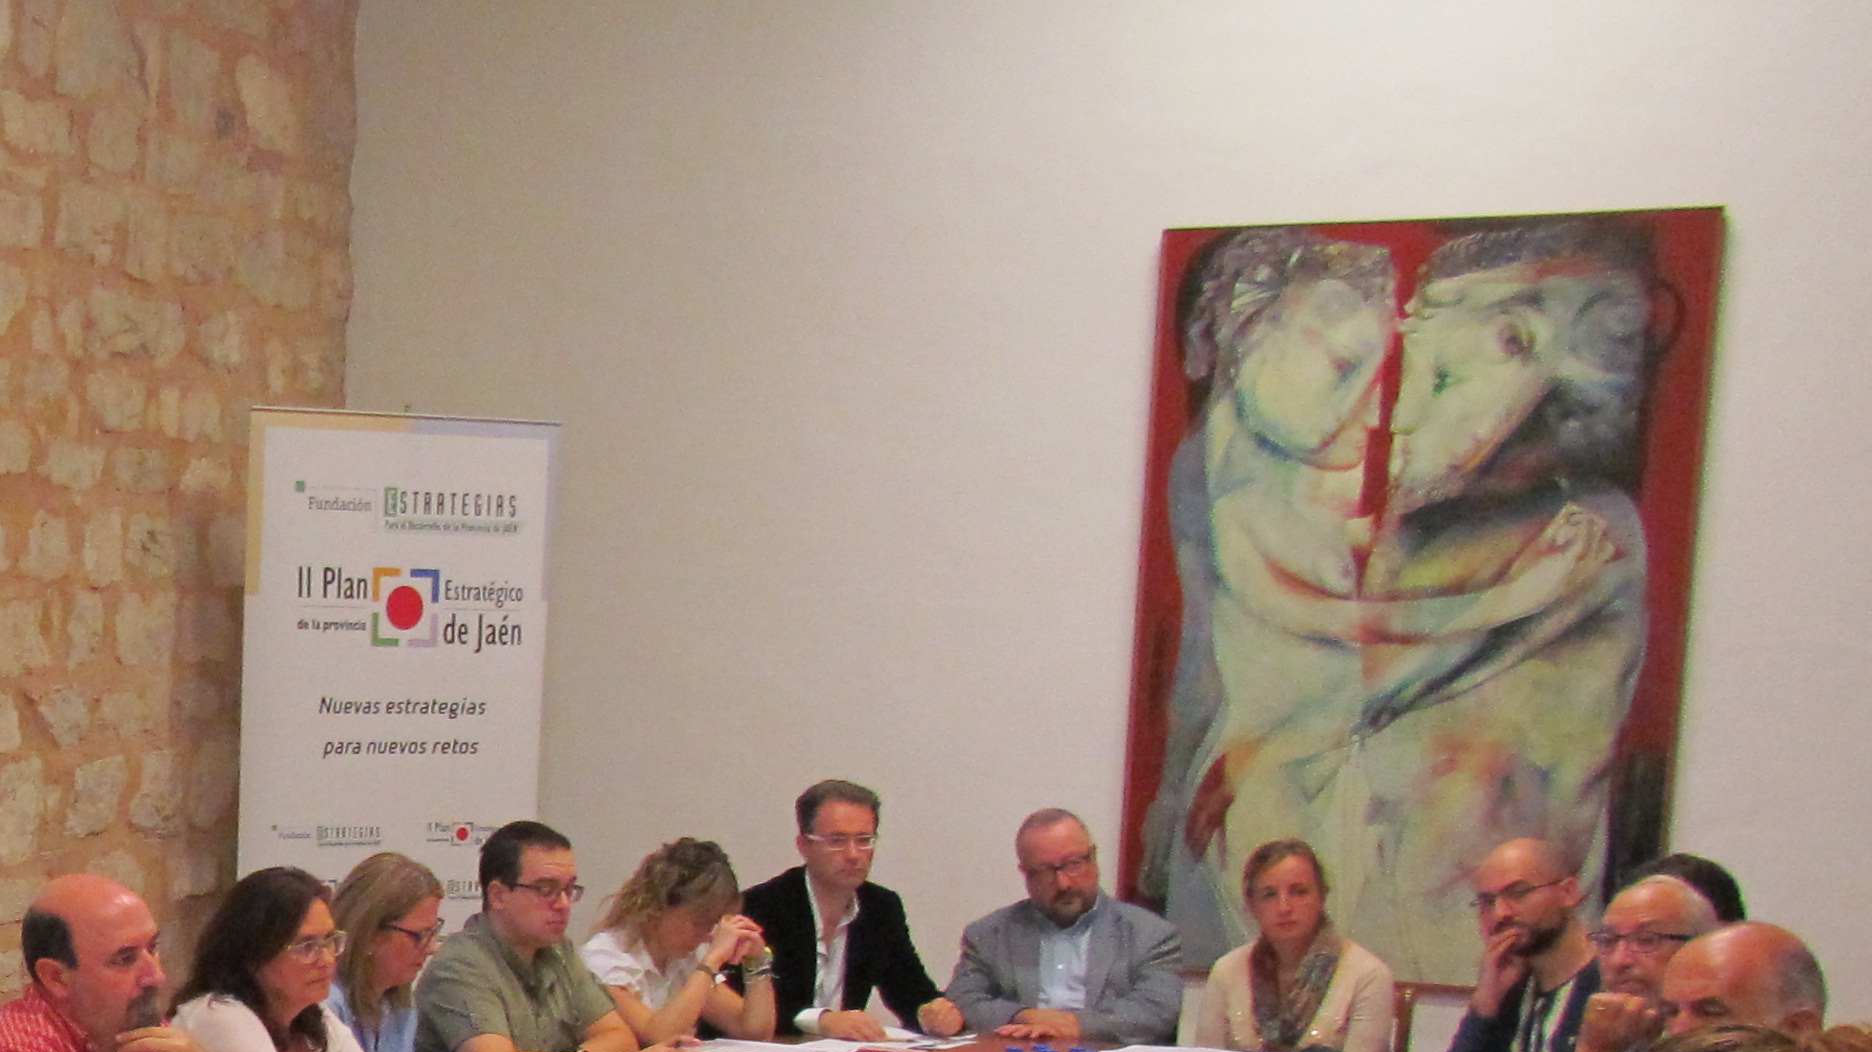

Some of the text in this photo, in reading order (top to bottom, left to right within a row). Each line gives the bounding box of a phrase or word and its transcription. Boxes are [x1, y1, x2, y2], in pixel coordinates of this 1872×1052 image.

[308, 487, 517, 518] Fundación ESTRATEGIAS
[297, 566, 524, 608] II Plan Estratégico
[297, 613, 523, 654] de la provincia de Jaén
[319, 696, 487, 719] Nuevas estrategias
[322, 739, 480, 760] para nuevos retos
